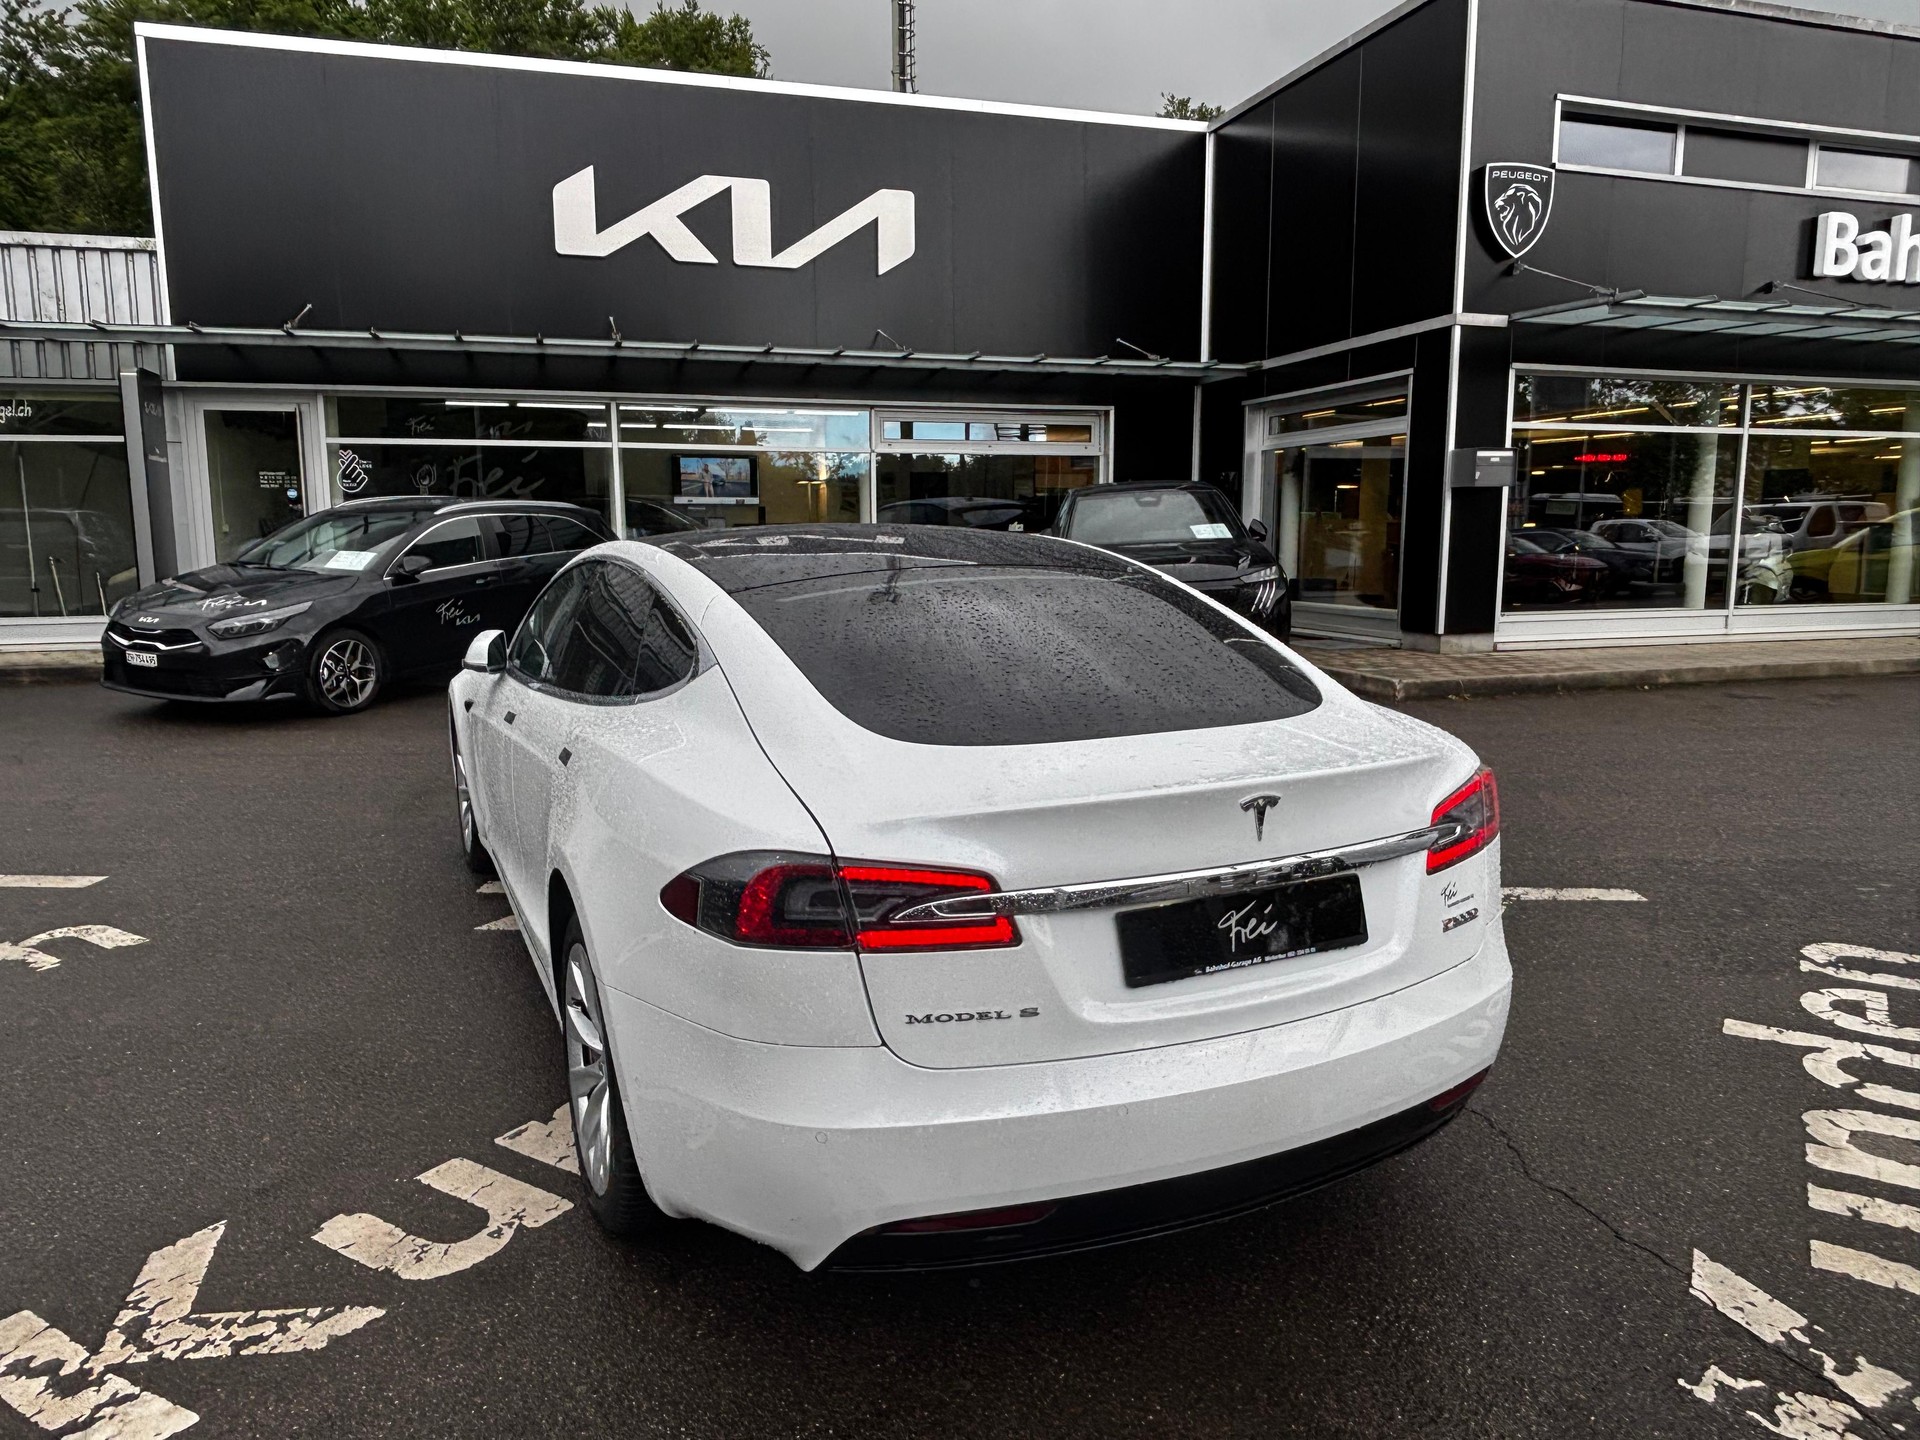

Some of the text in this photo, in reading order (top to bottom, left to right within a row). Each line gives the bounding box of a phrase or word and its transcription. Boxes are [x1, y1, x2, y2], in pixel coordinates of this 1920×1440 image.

[1491, 170, 1549, 183] PEUGEOT
[552, 164, 915, 276] KIA
[1813, 211, 1920, 283] Bah
[1217, 900, 1278, 953] Frei
[904, 1007, 1041, 1025] MODEL S
